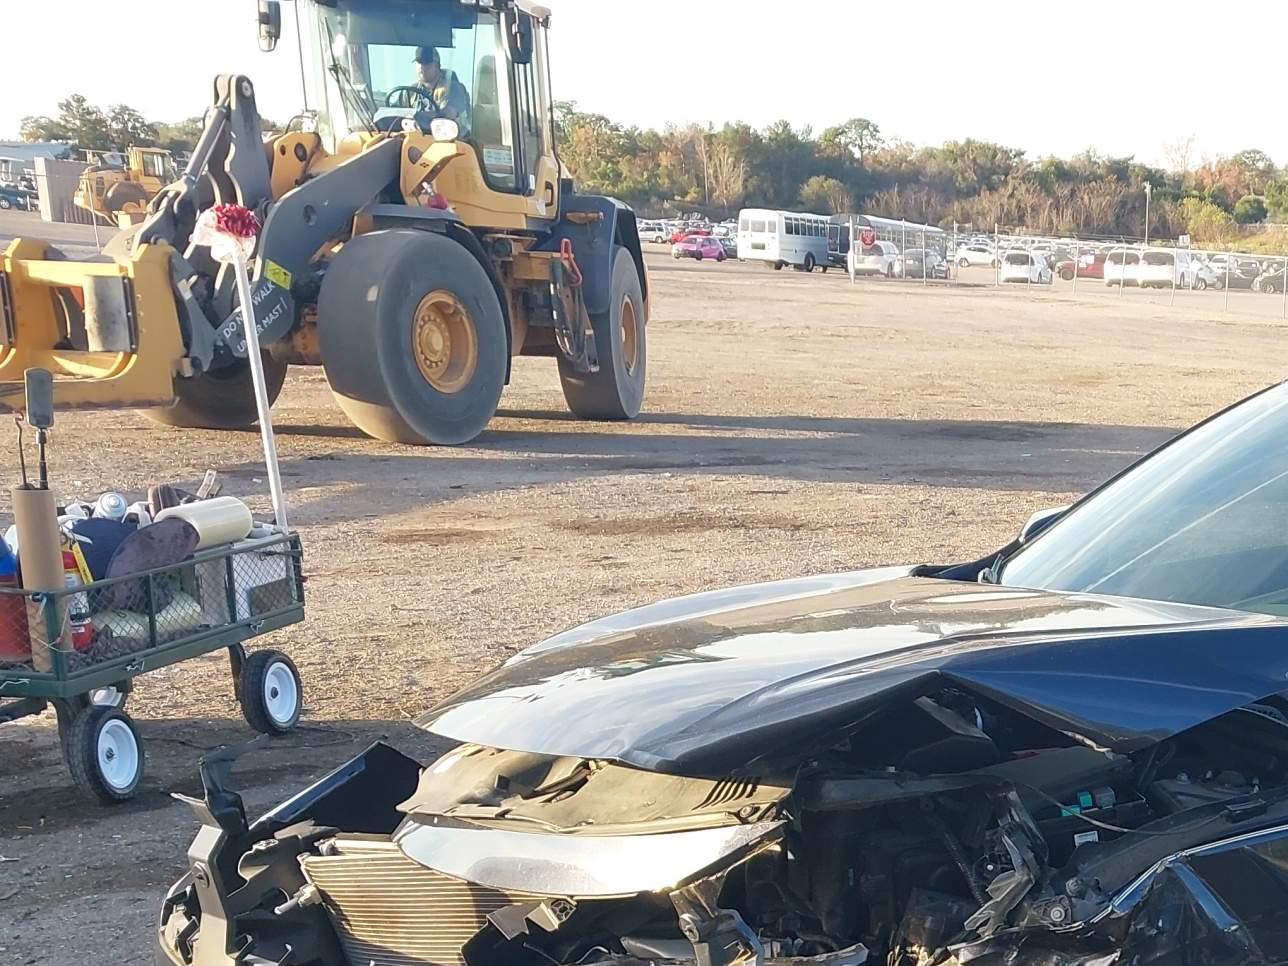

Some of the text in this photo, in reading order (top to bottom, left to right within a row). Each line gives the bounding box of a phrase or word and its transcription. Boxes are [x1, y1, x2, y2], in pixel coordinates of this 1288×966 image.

[223, 281, 276, 339] DO WALK
[261, 303, 283, 328] MAST
